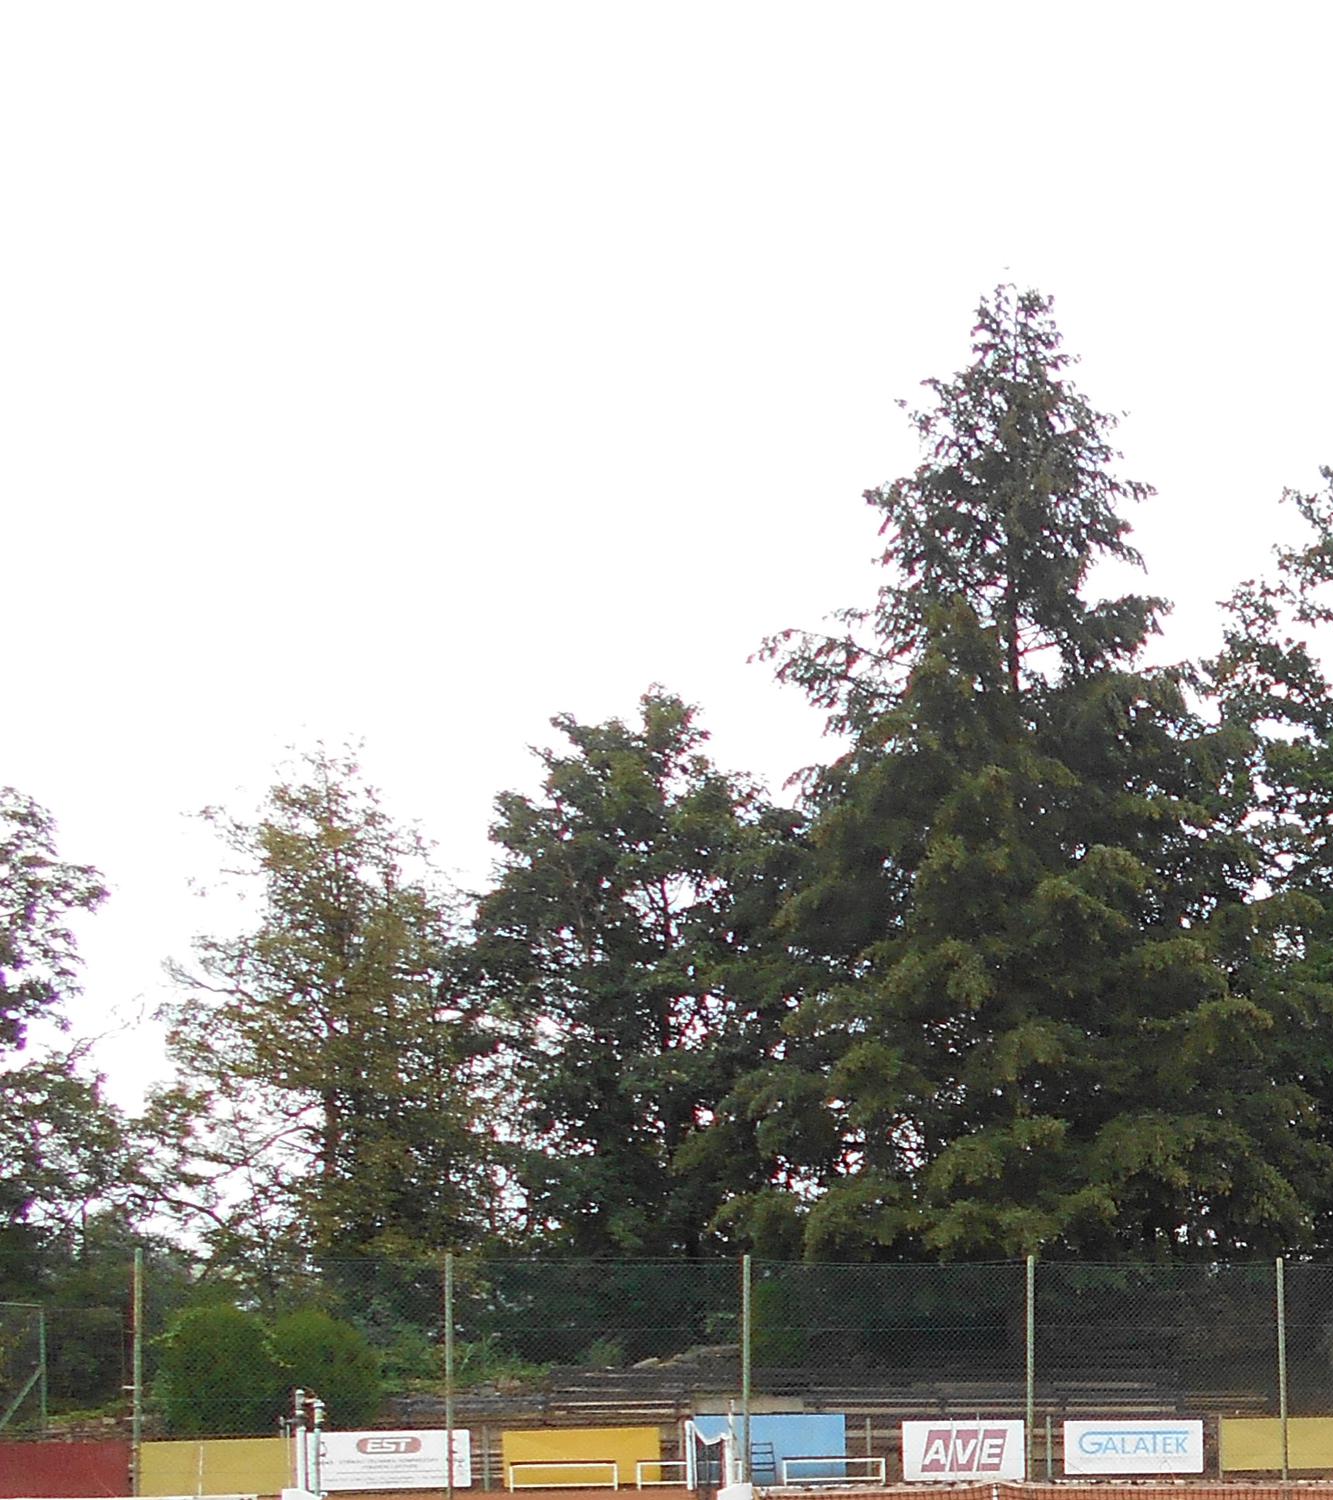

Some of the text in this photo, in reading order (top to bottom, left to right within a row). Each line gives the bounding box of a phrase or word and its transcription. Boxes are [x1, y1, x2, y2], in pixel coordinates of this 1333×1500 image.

[365, 1438, 412, 1453] EST
[923, 1438, 1005, 1465] AVE
[1078, 1430, 1190, 1455] GALATEK
